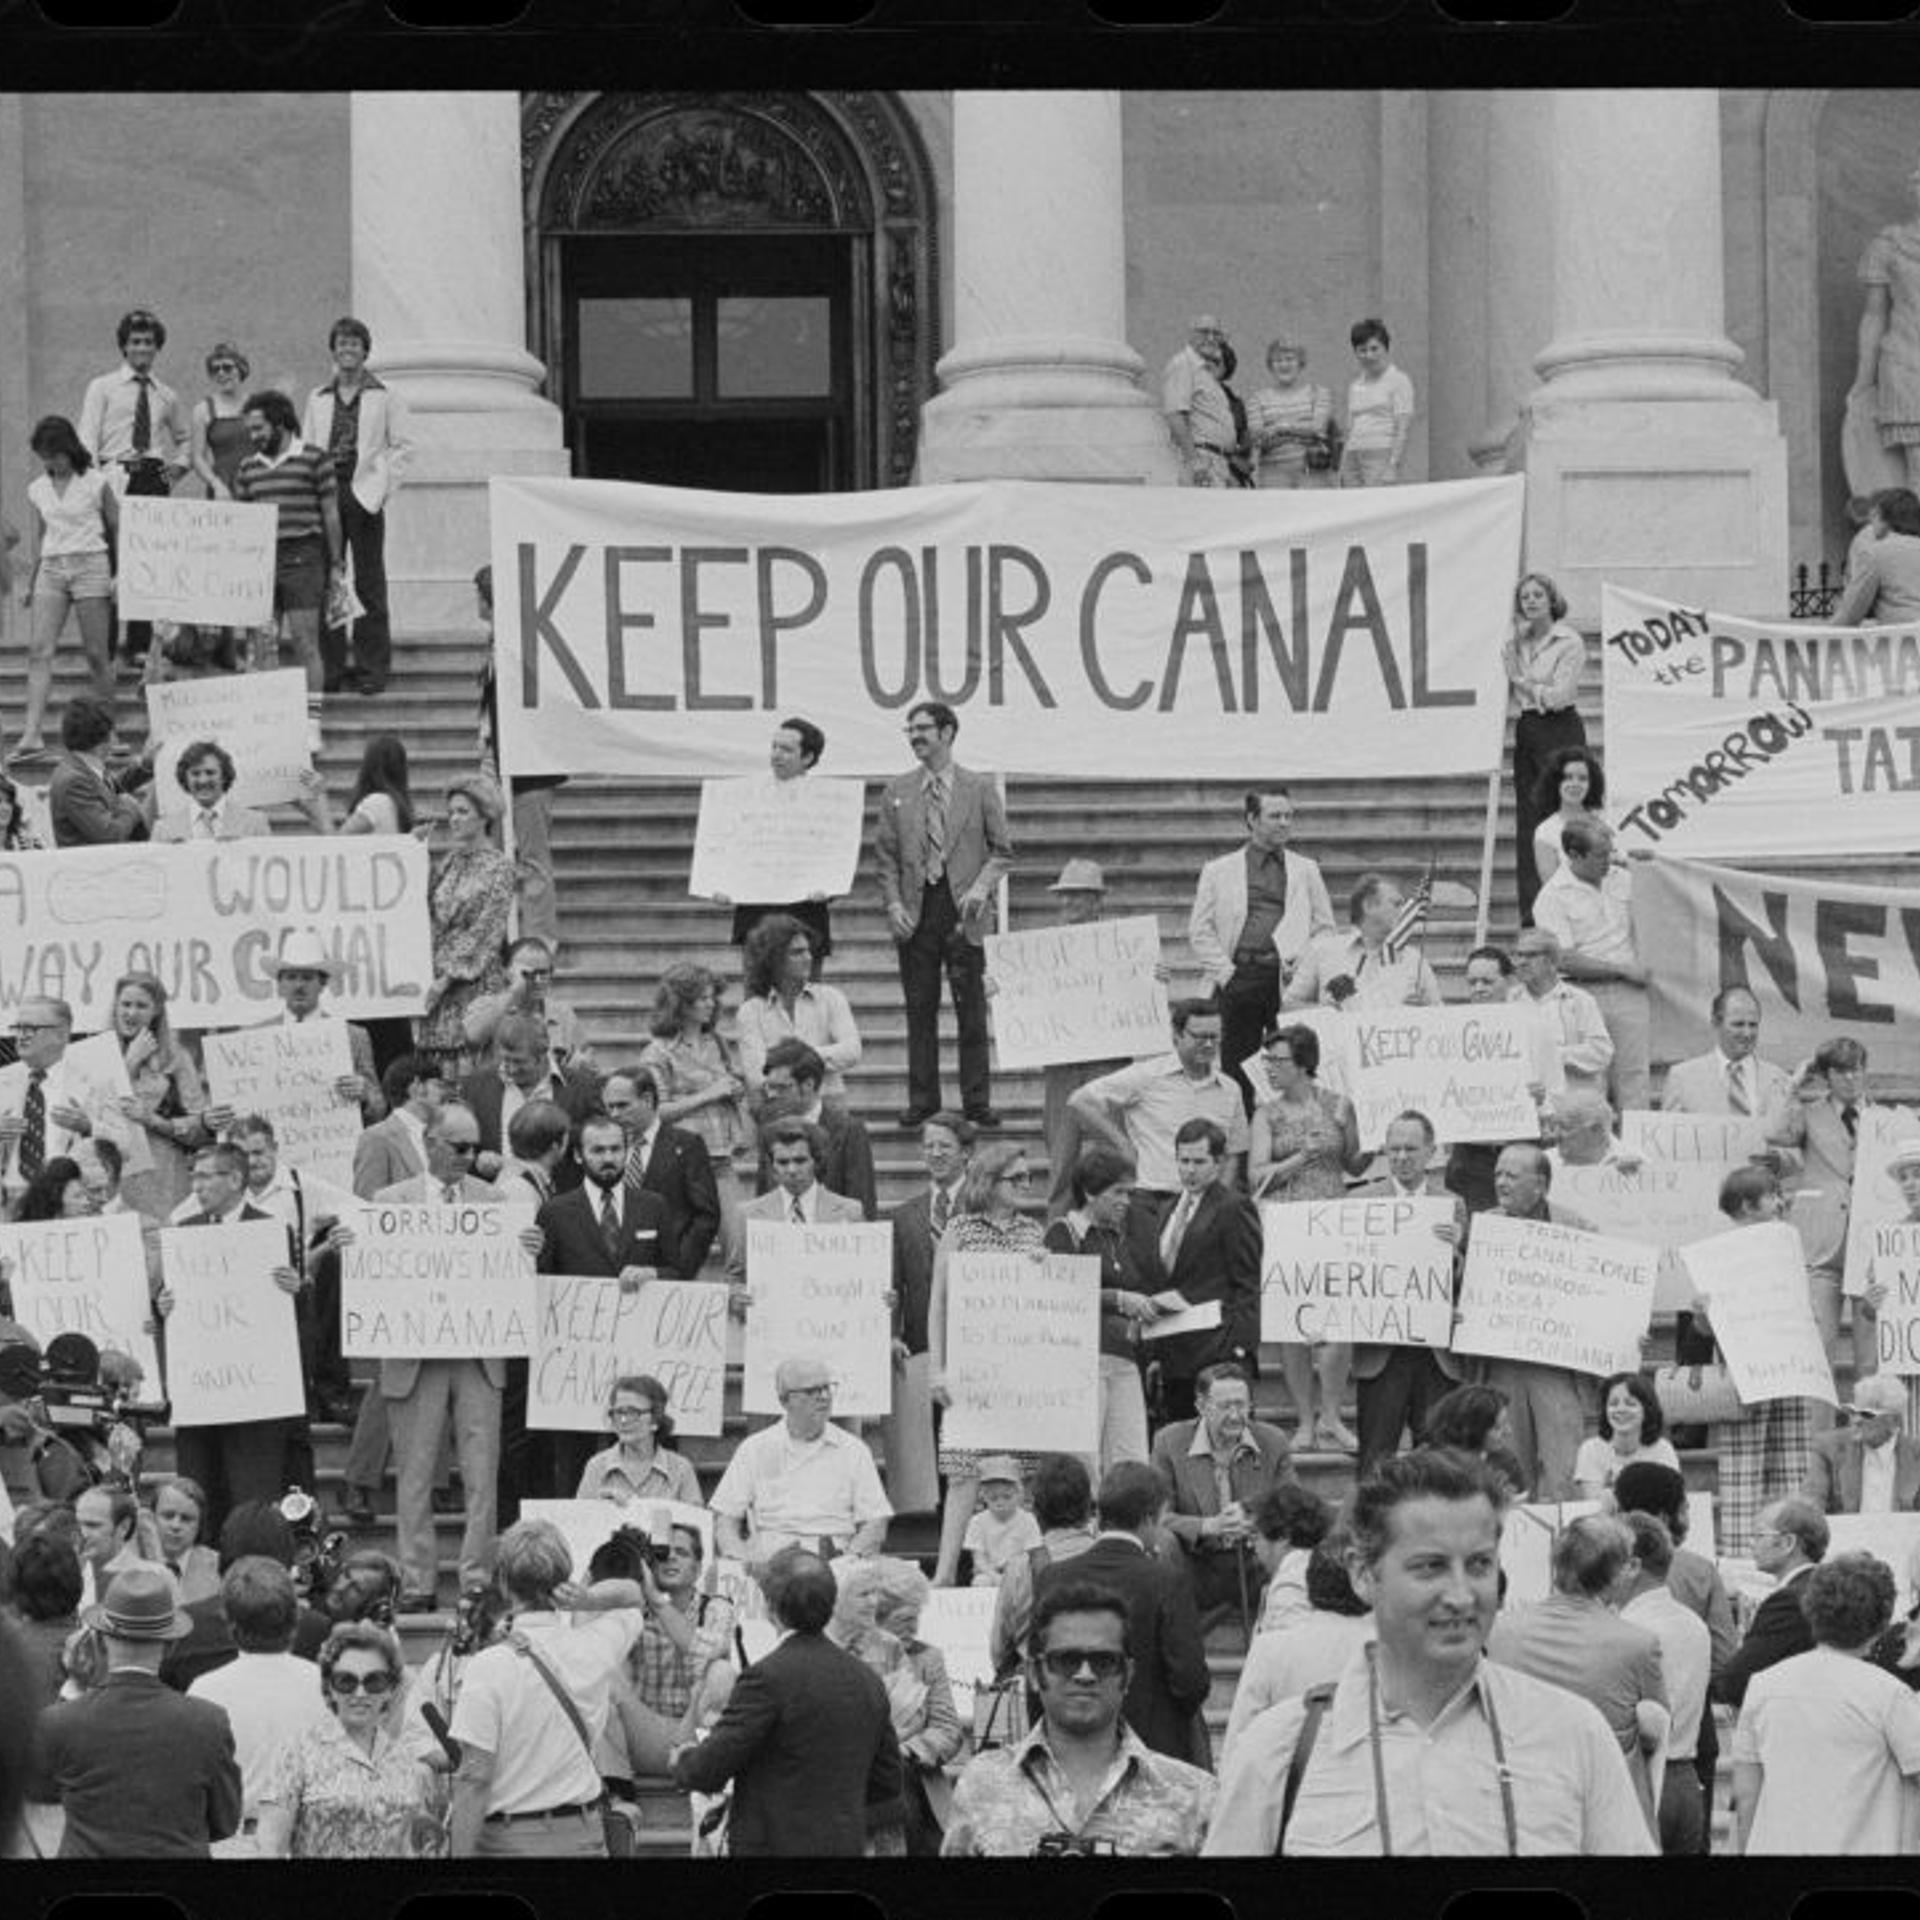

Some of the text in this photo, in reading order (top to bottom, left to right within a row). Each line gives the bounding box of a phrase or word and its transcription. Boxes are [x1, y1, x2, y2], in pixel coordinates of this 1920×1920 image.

[517, 541, 1477, 713] KEEP OUR CANAL
[1606, 608, 1711, 666] TODAY
[1653, 635, 1920, 701] the PANAMA
[1617, 701, 1813, 843] TOMORROW
[207, 853, 409, 918] WOULD
[233, 922, 423, 1002] CAL
[1356, 1024, 1422, 1069] KEEP
[1640, 1121, 1742, 1162] KEEP
[358, 1206, 503, 1237] TORRIJOS
[1306, 1201, 1415, 1238] KEEP
[17, 1228, 111, 1284] KEEP
[1343, 1241, 1381, 1258] THE
[1518, 1241, 1578, 1273] CANAL
[1586, 1254, 1648, 1288] ZONE
[1260, 1259, 1452, 1303] AMERICAN
[344, 1306, 528, 1348] PANAMA
[543, 1280, 727, 1351] KEEP OUR
[1295, 1302, 1428, 1344] CANAL
[536, 1346, 650, 1409] CANA
